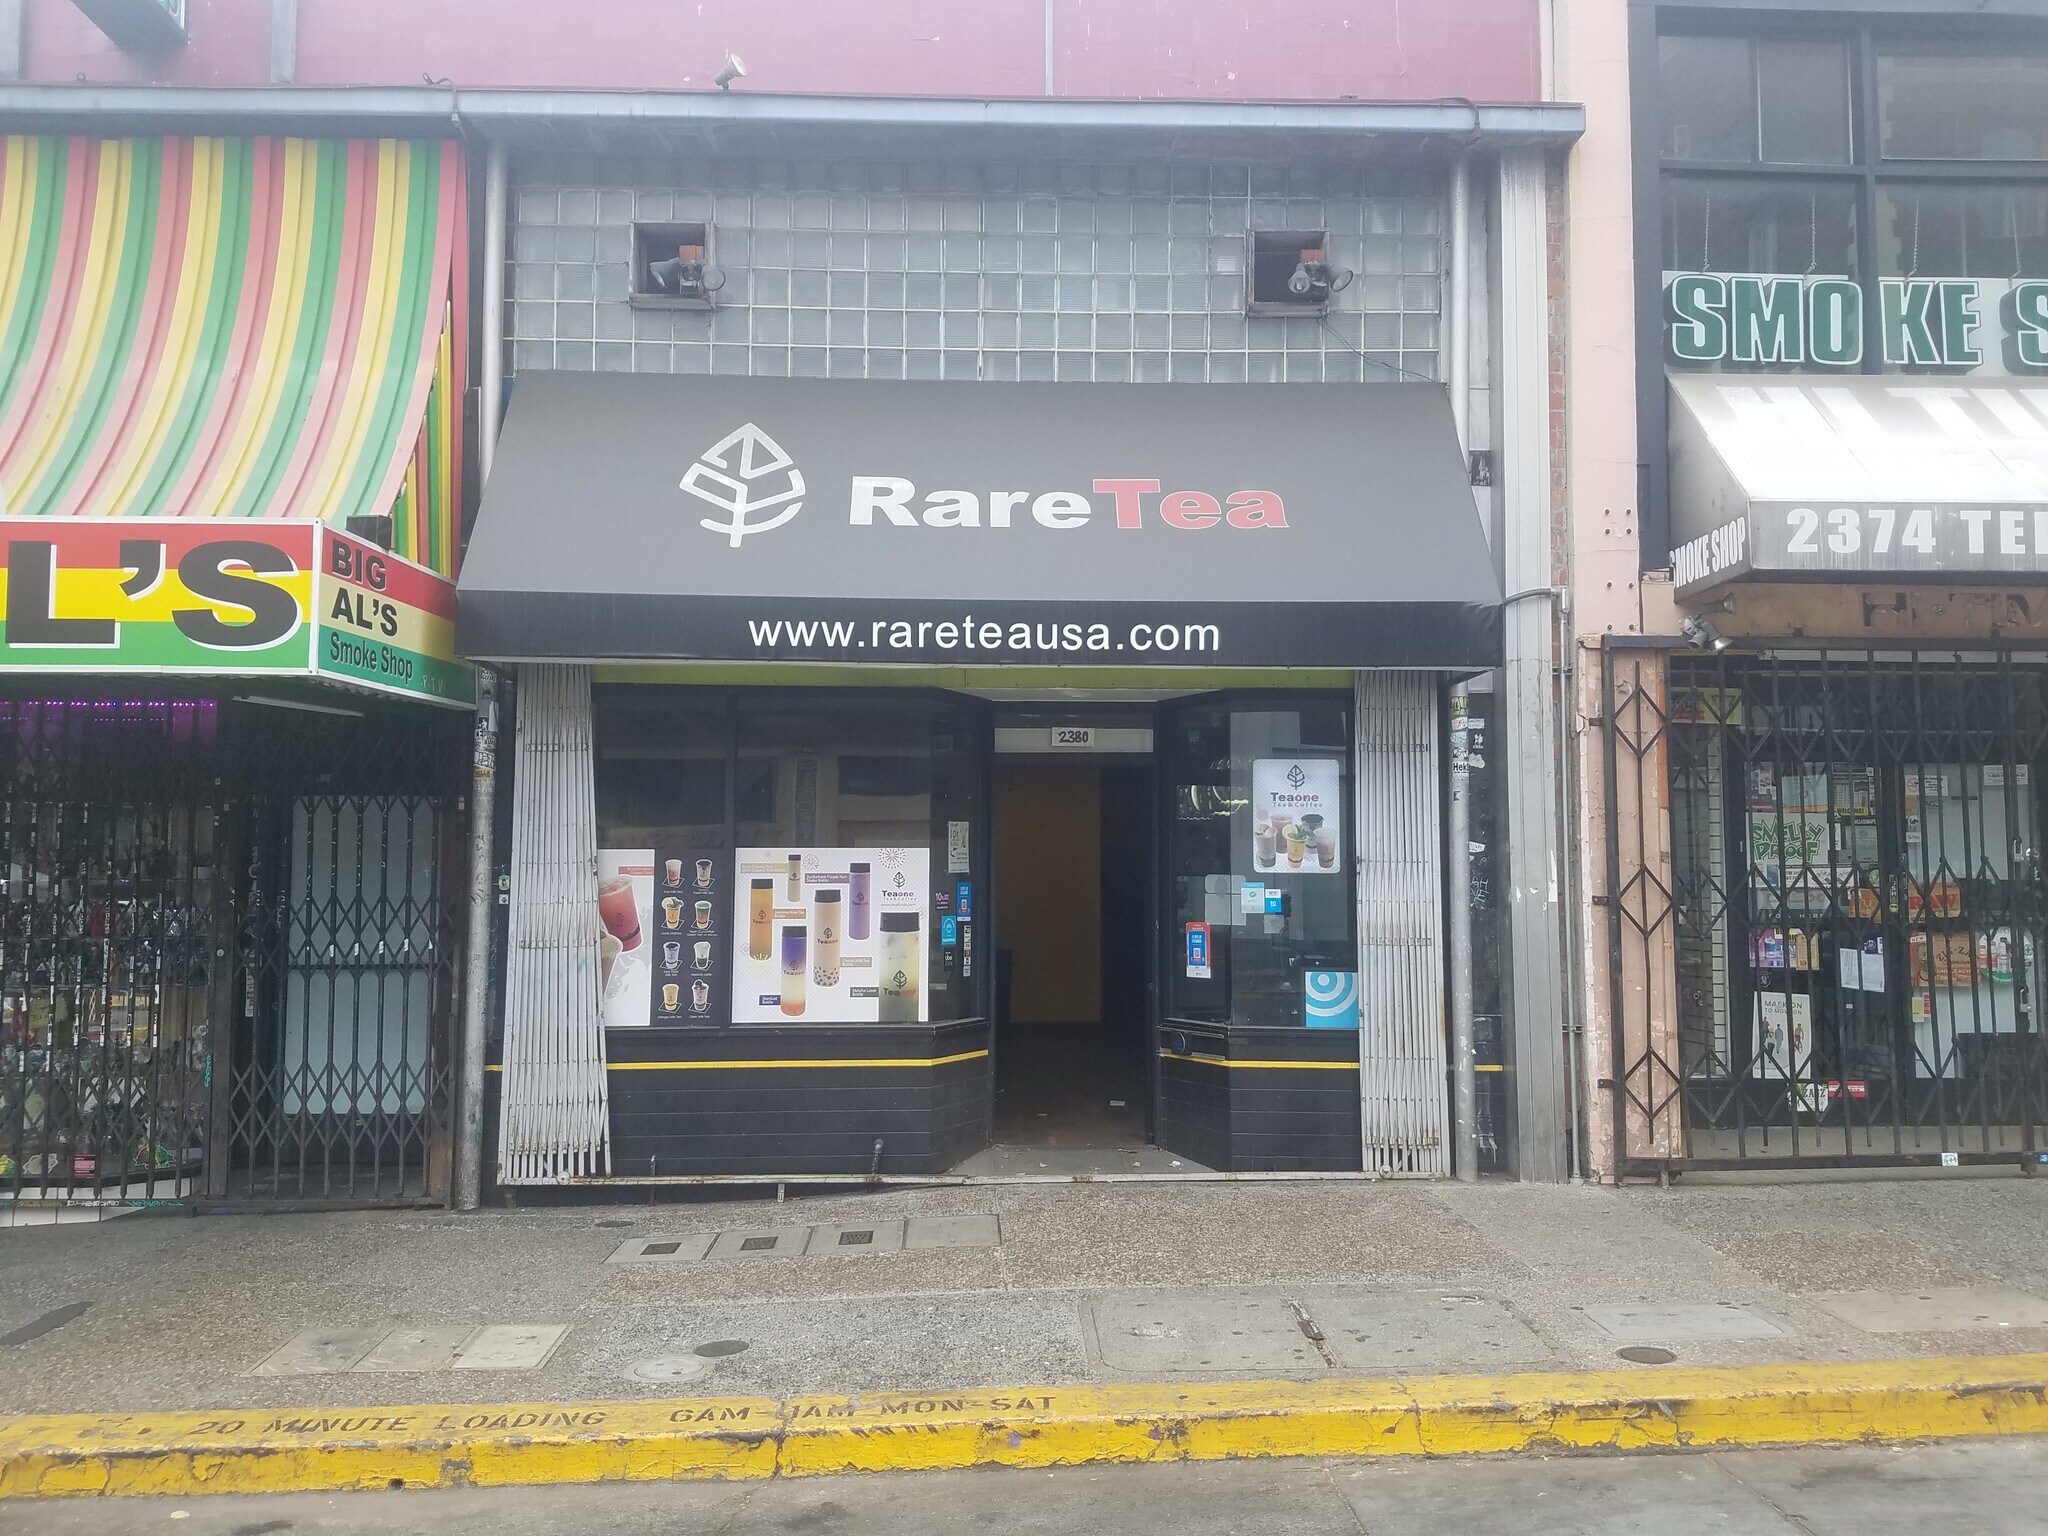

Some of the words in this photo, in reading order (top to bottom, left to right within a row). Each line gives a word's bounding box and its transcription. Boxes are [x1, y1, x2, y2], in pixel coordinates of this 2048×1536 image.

[1671, 275, 1985, 366] SMOKE
[1669, 533, 1710, 588] SMOKE
[1711, 516, 1746, 573] SHOP
[1786, 508, 1936, 554] 2374
[1960, 509, 2048, 555] TE
[332, 538, 387, 592] BIG
[331, 586, 398, 637] AL'S
[747, 613, 1220, 652] www.rareteausa.com
[330, 631, 377, 671] Smoke
[381, 645, 413, 685] Shop
[1057, 730, 1089, 744] 2380
[1270, 792, 1319, 802] Teaone
[881, 890, 915, 898] Teaone
[1764, 1000, 1787, 1009] MASK
[187, 1419, 245, 1436] 20
[262, 1415, 418, 1434] MINUTE
[433, 1411, 609, 1431] LOADING
